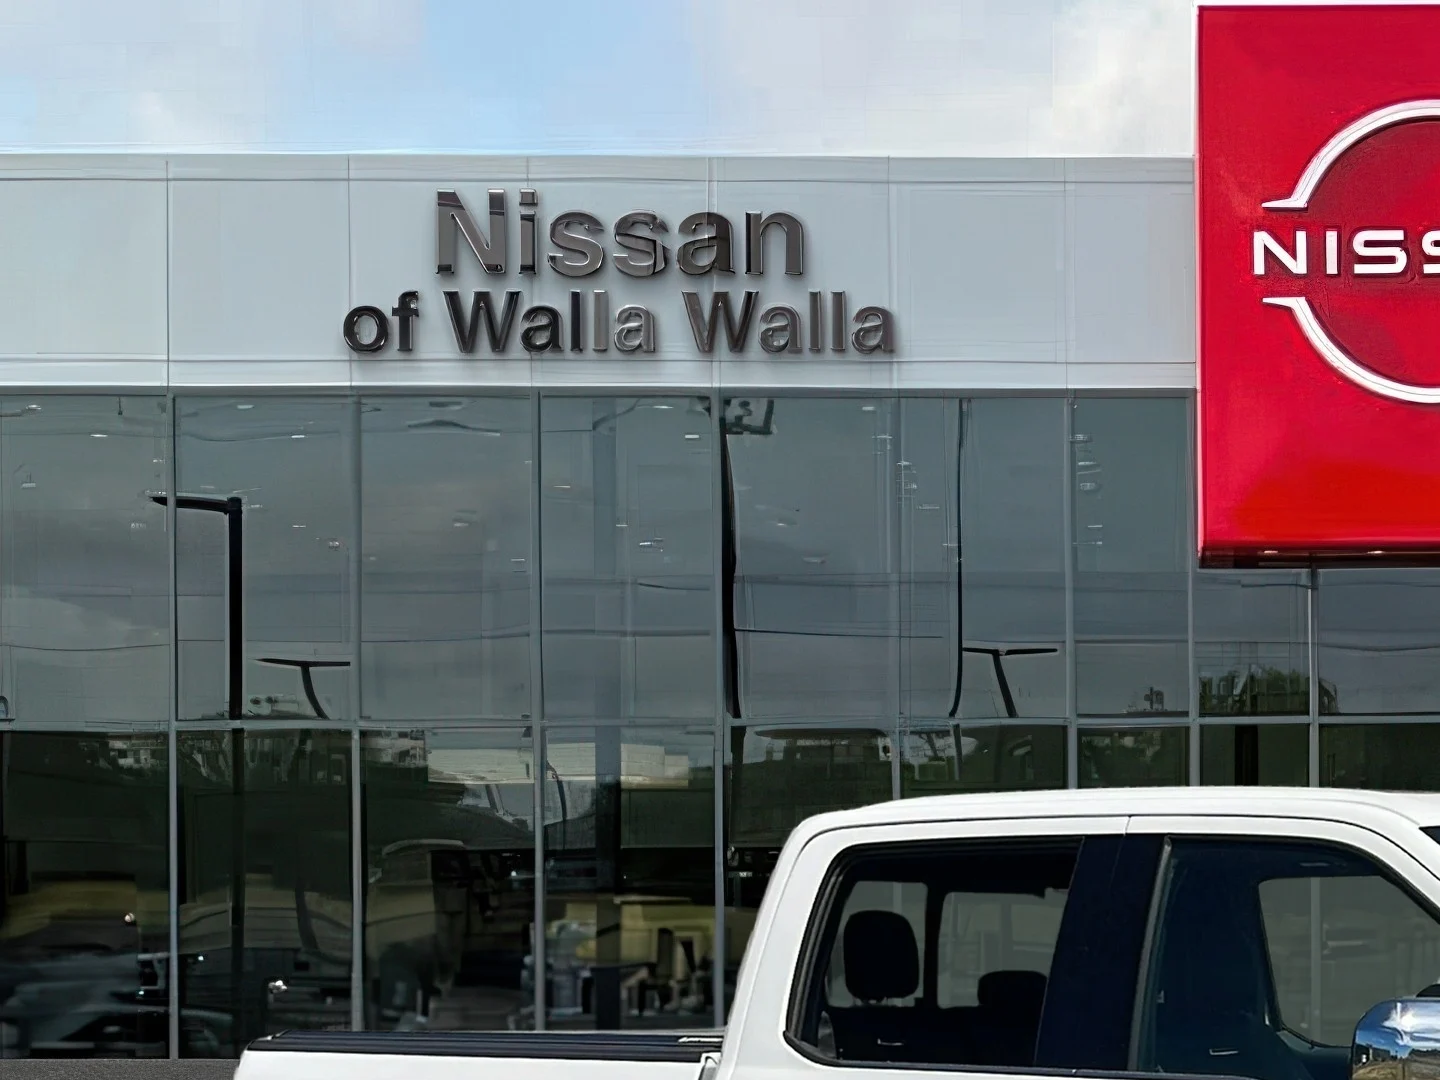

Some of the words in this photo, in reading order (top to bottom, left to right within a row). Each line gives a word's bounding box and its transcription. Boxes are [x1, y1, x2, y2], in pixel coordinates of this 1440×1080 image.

[435, 188, 805, 277] Nissan
[343, 289, 420, 354] of
[442, 289, 656, 354] Walla
[681, 289, 895, 354] Walla
